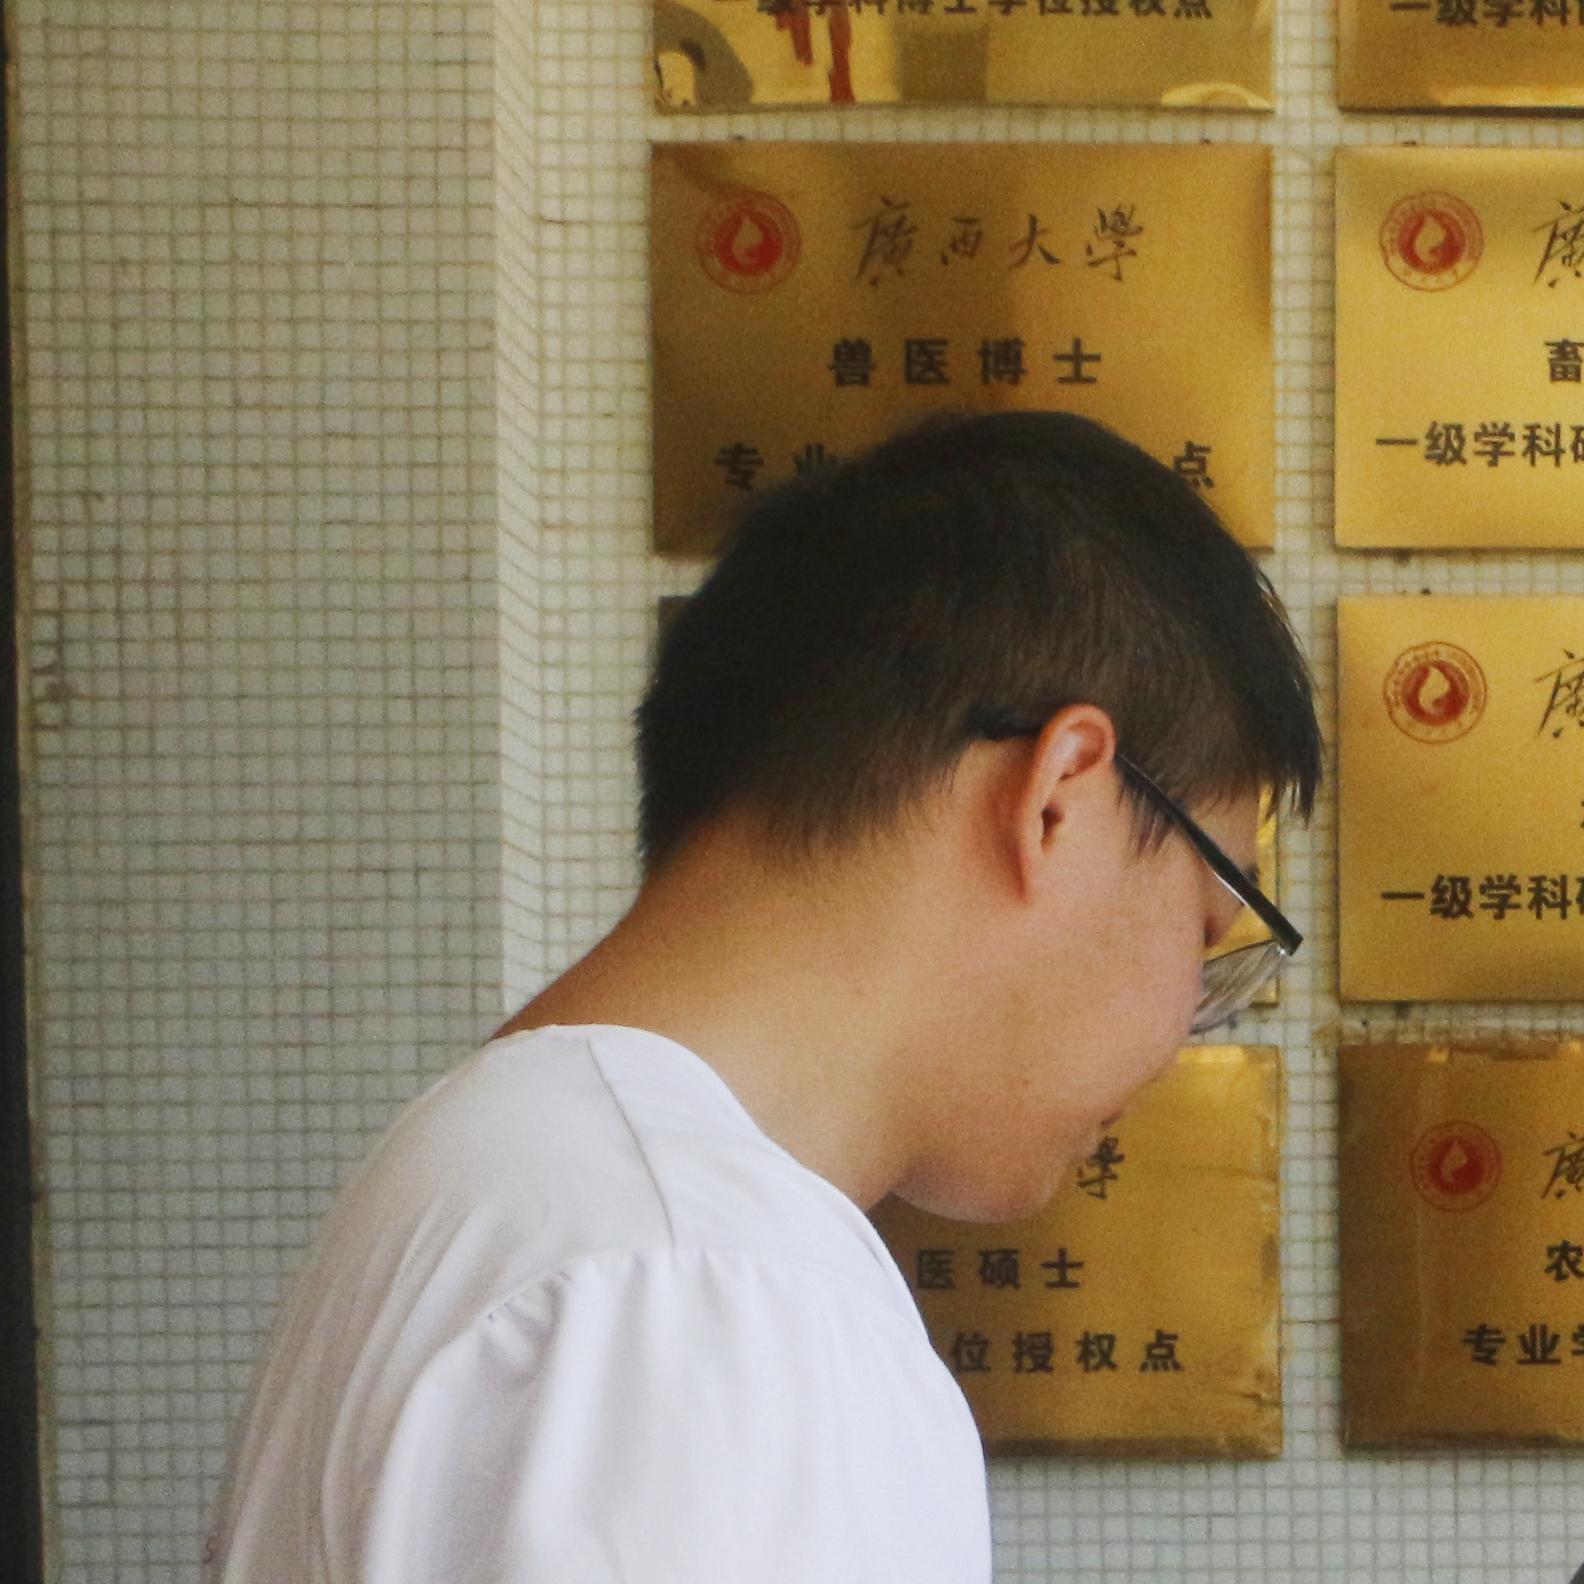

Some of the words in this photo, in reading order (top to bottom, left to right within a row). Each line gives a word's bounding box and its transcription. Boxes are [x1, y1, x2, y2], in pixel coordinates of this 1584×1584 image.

[828, 338, 1101, 386] 兽医博士
[915, 1247, 1084, 1291] 医硕士
[950, 1329, 1184, 1374] 位授权点
